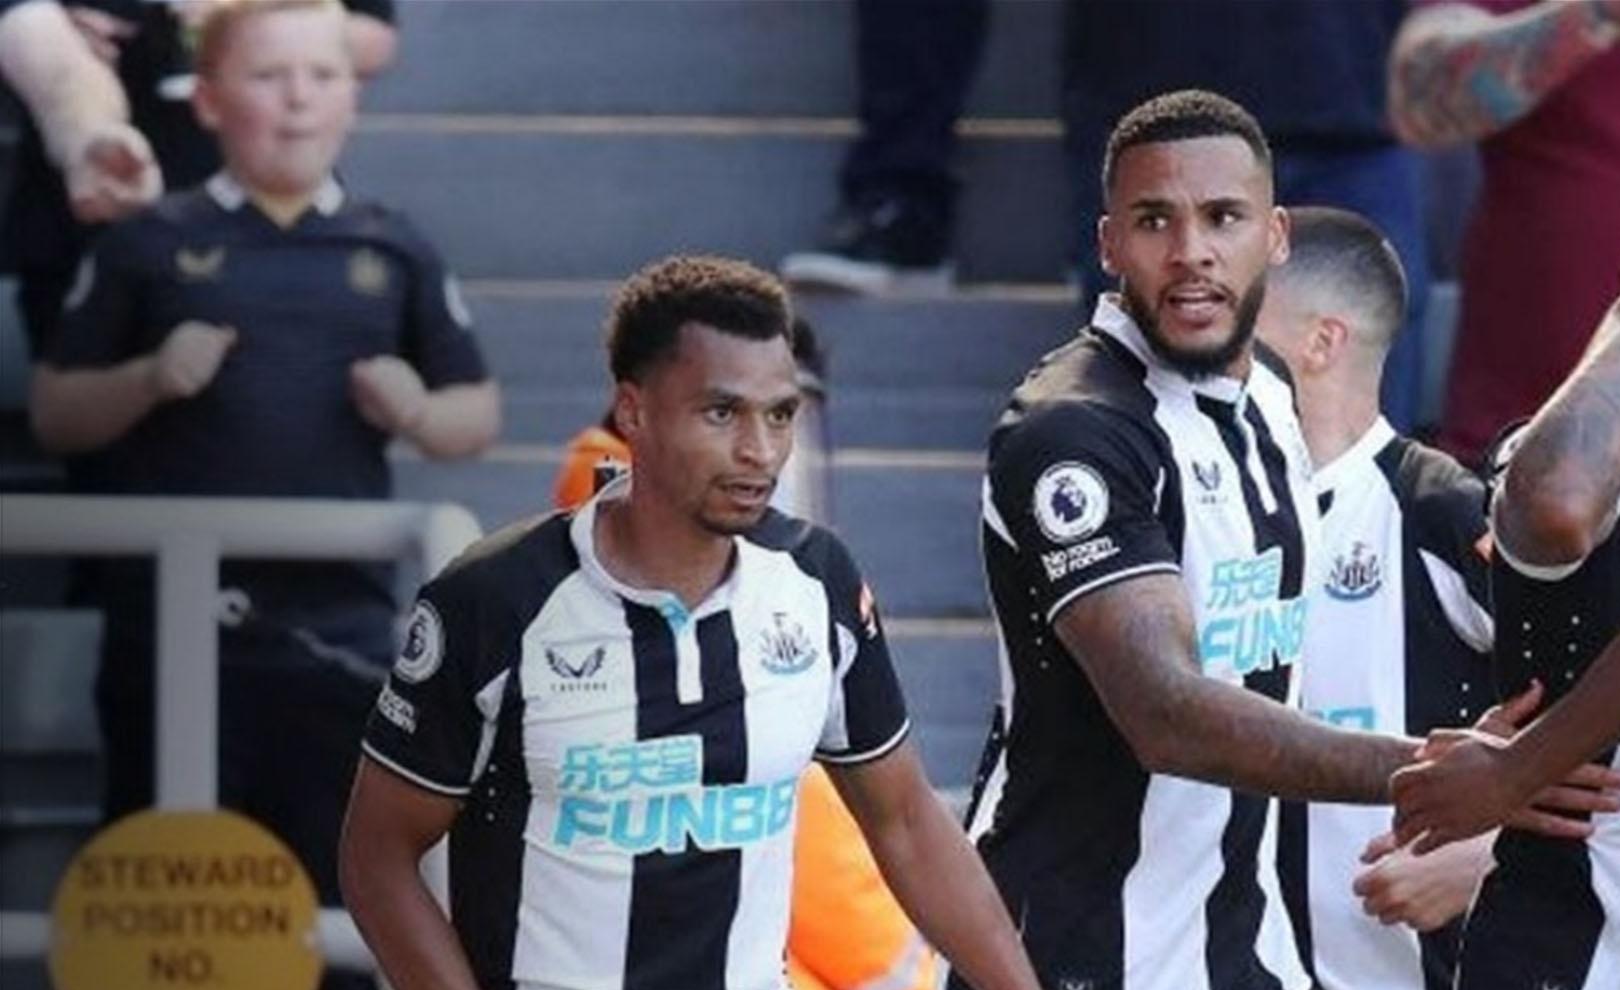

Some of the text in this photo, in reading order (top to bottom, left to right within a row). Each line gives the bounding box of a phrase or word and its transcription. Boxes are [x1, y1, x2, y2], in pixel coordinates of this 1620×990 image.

[557, 736, 701, 794] 乐天堂
[80, 854, 294, 890] STEWARD
[83, 901, 290, 938] POSITION
